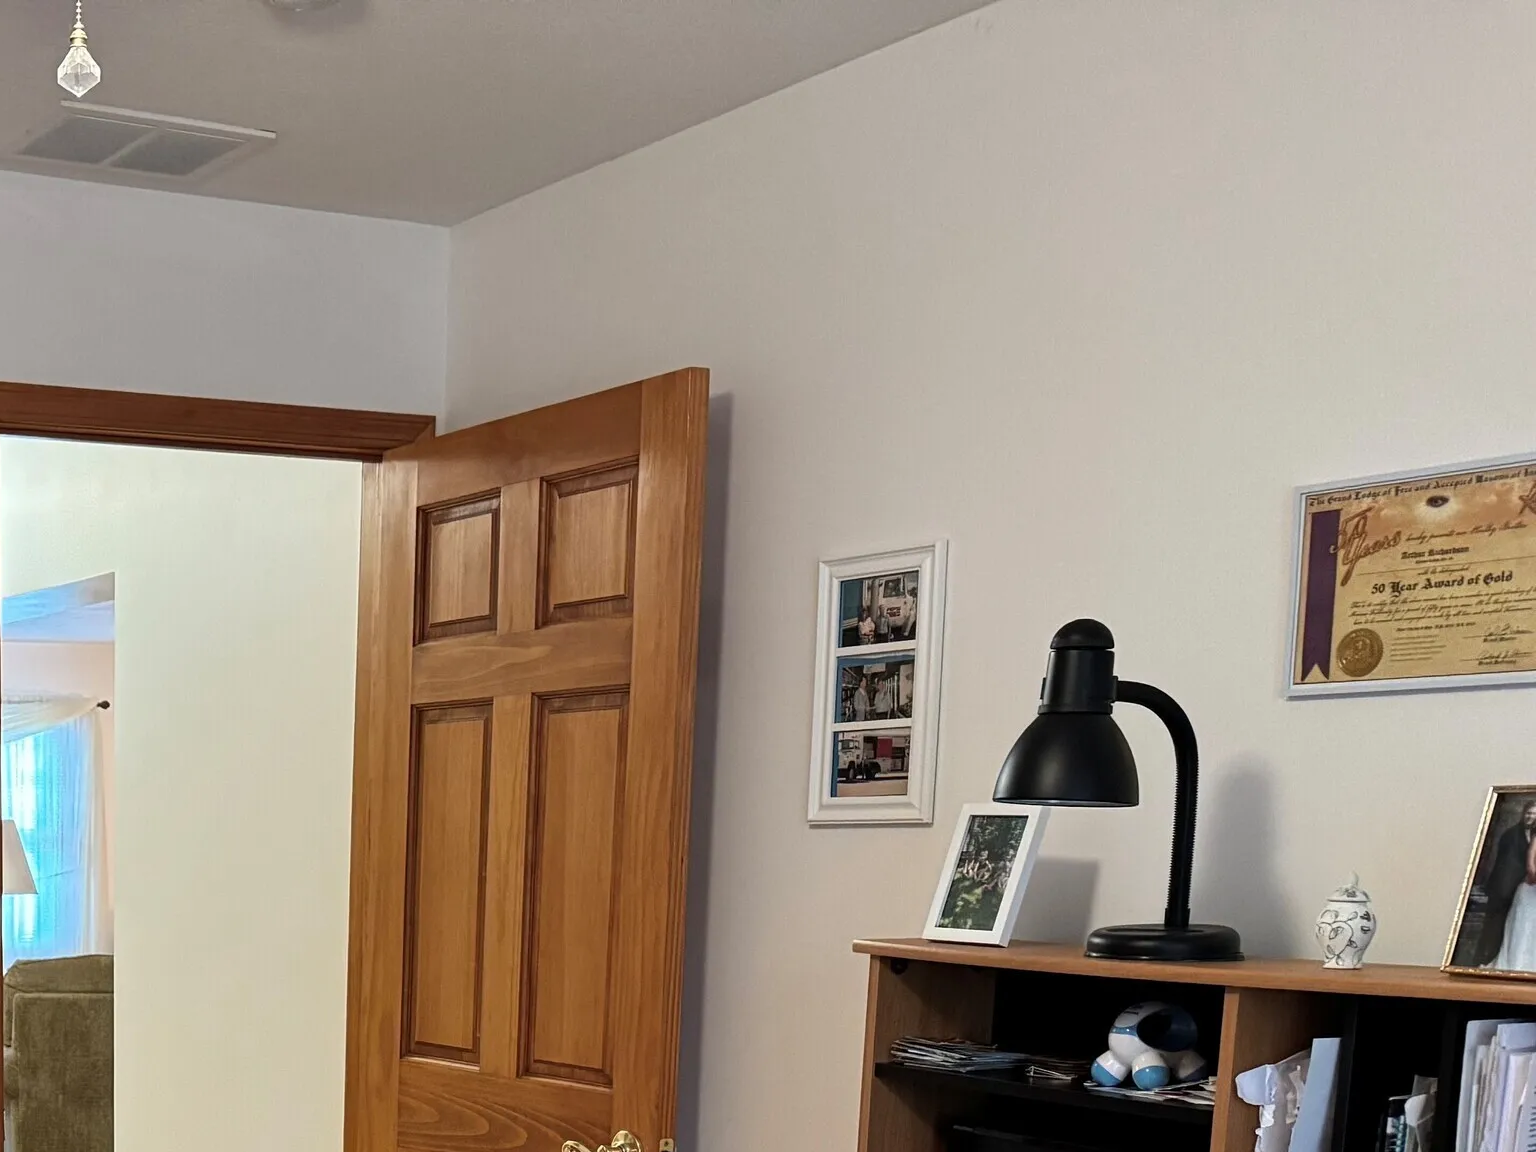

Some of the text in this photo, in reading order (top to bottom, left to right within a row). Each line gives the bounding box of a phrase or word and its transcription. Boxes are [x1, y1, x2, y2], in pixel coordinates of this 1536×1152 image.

[1327, 494, 1352, 504] Grand
[1354, 490, 1381, 500] Lodge
[1414, 482, 1430, 491] and
[1371, 583, 1386, 594] 50
[1389, 580, 1418, 598] Year
[1422, 575, 1464, 589] Award
[1468, 573, 1482, 585] of
[1483, 569, 1513, 586] Gold
